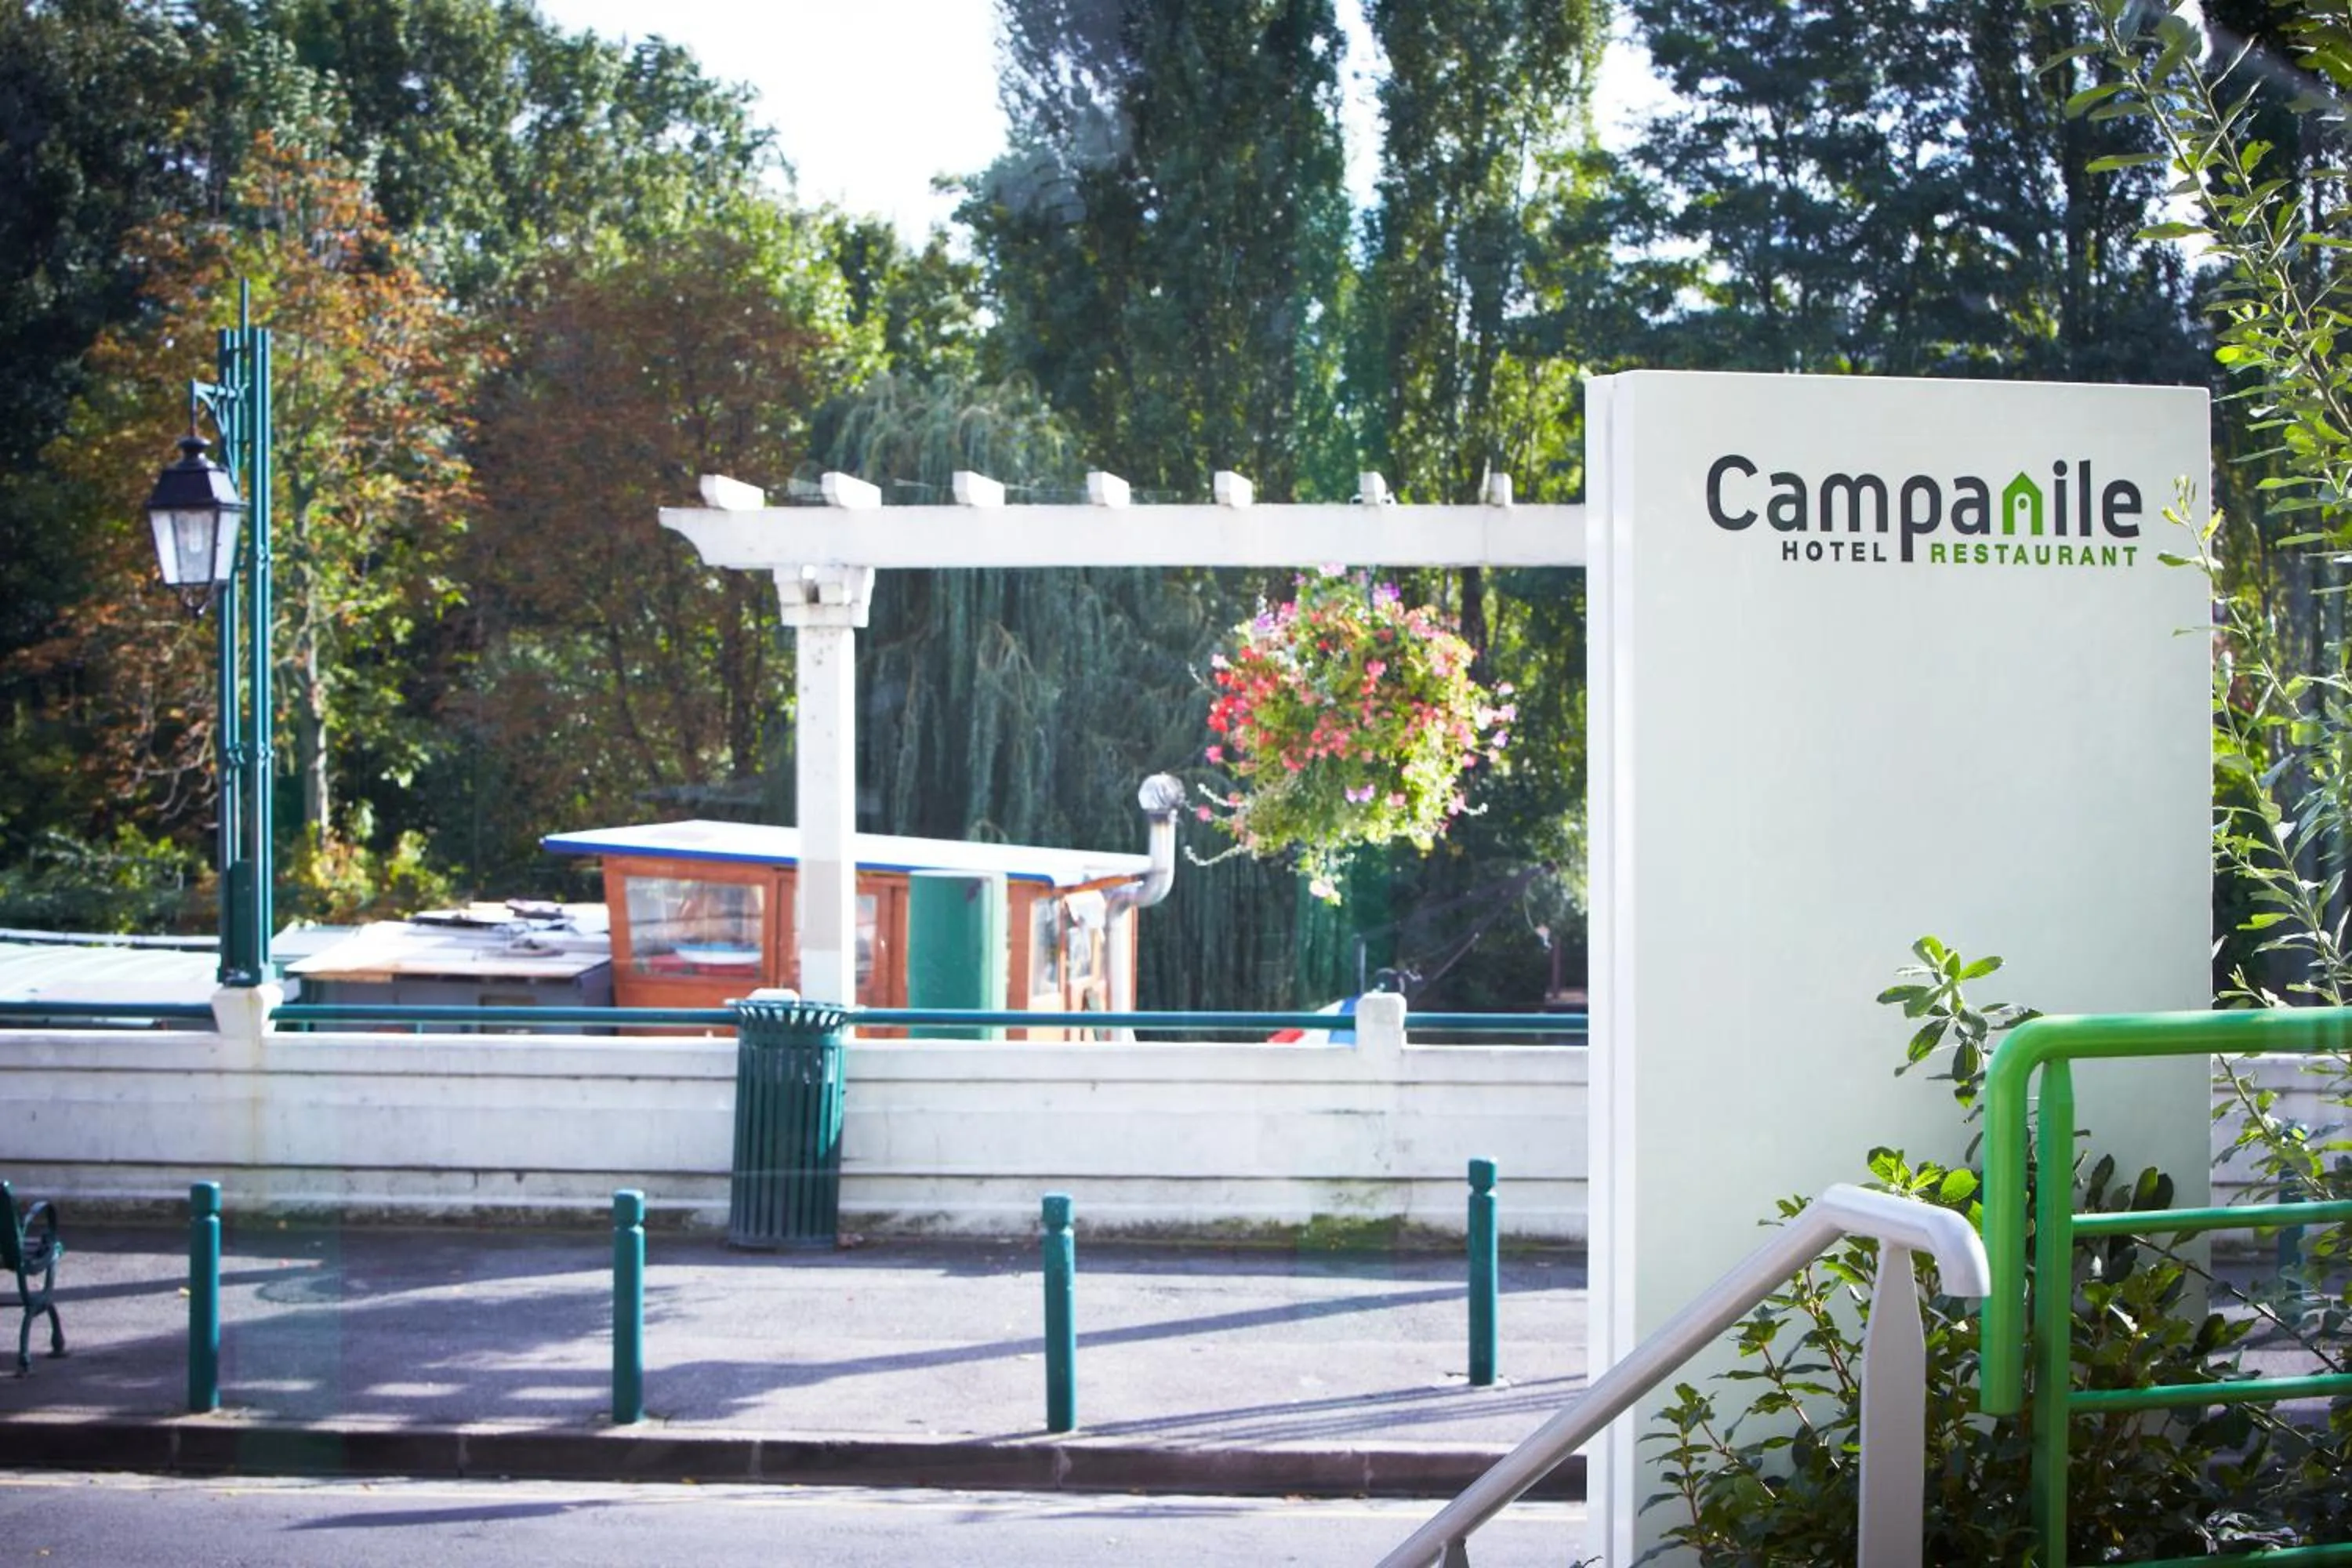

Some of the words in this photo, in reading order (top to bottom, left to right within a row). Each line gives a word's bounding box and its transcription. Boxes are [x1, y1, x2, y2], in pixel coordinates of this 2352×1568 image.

[1705, 453, 2143, 562] Campanile
[1781, 540, 1887, 562] HOTEL
[1930, 543, 2138, 567] RESTAURANT
